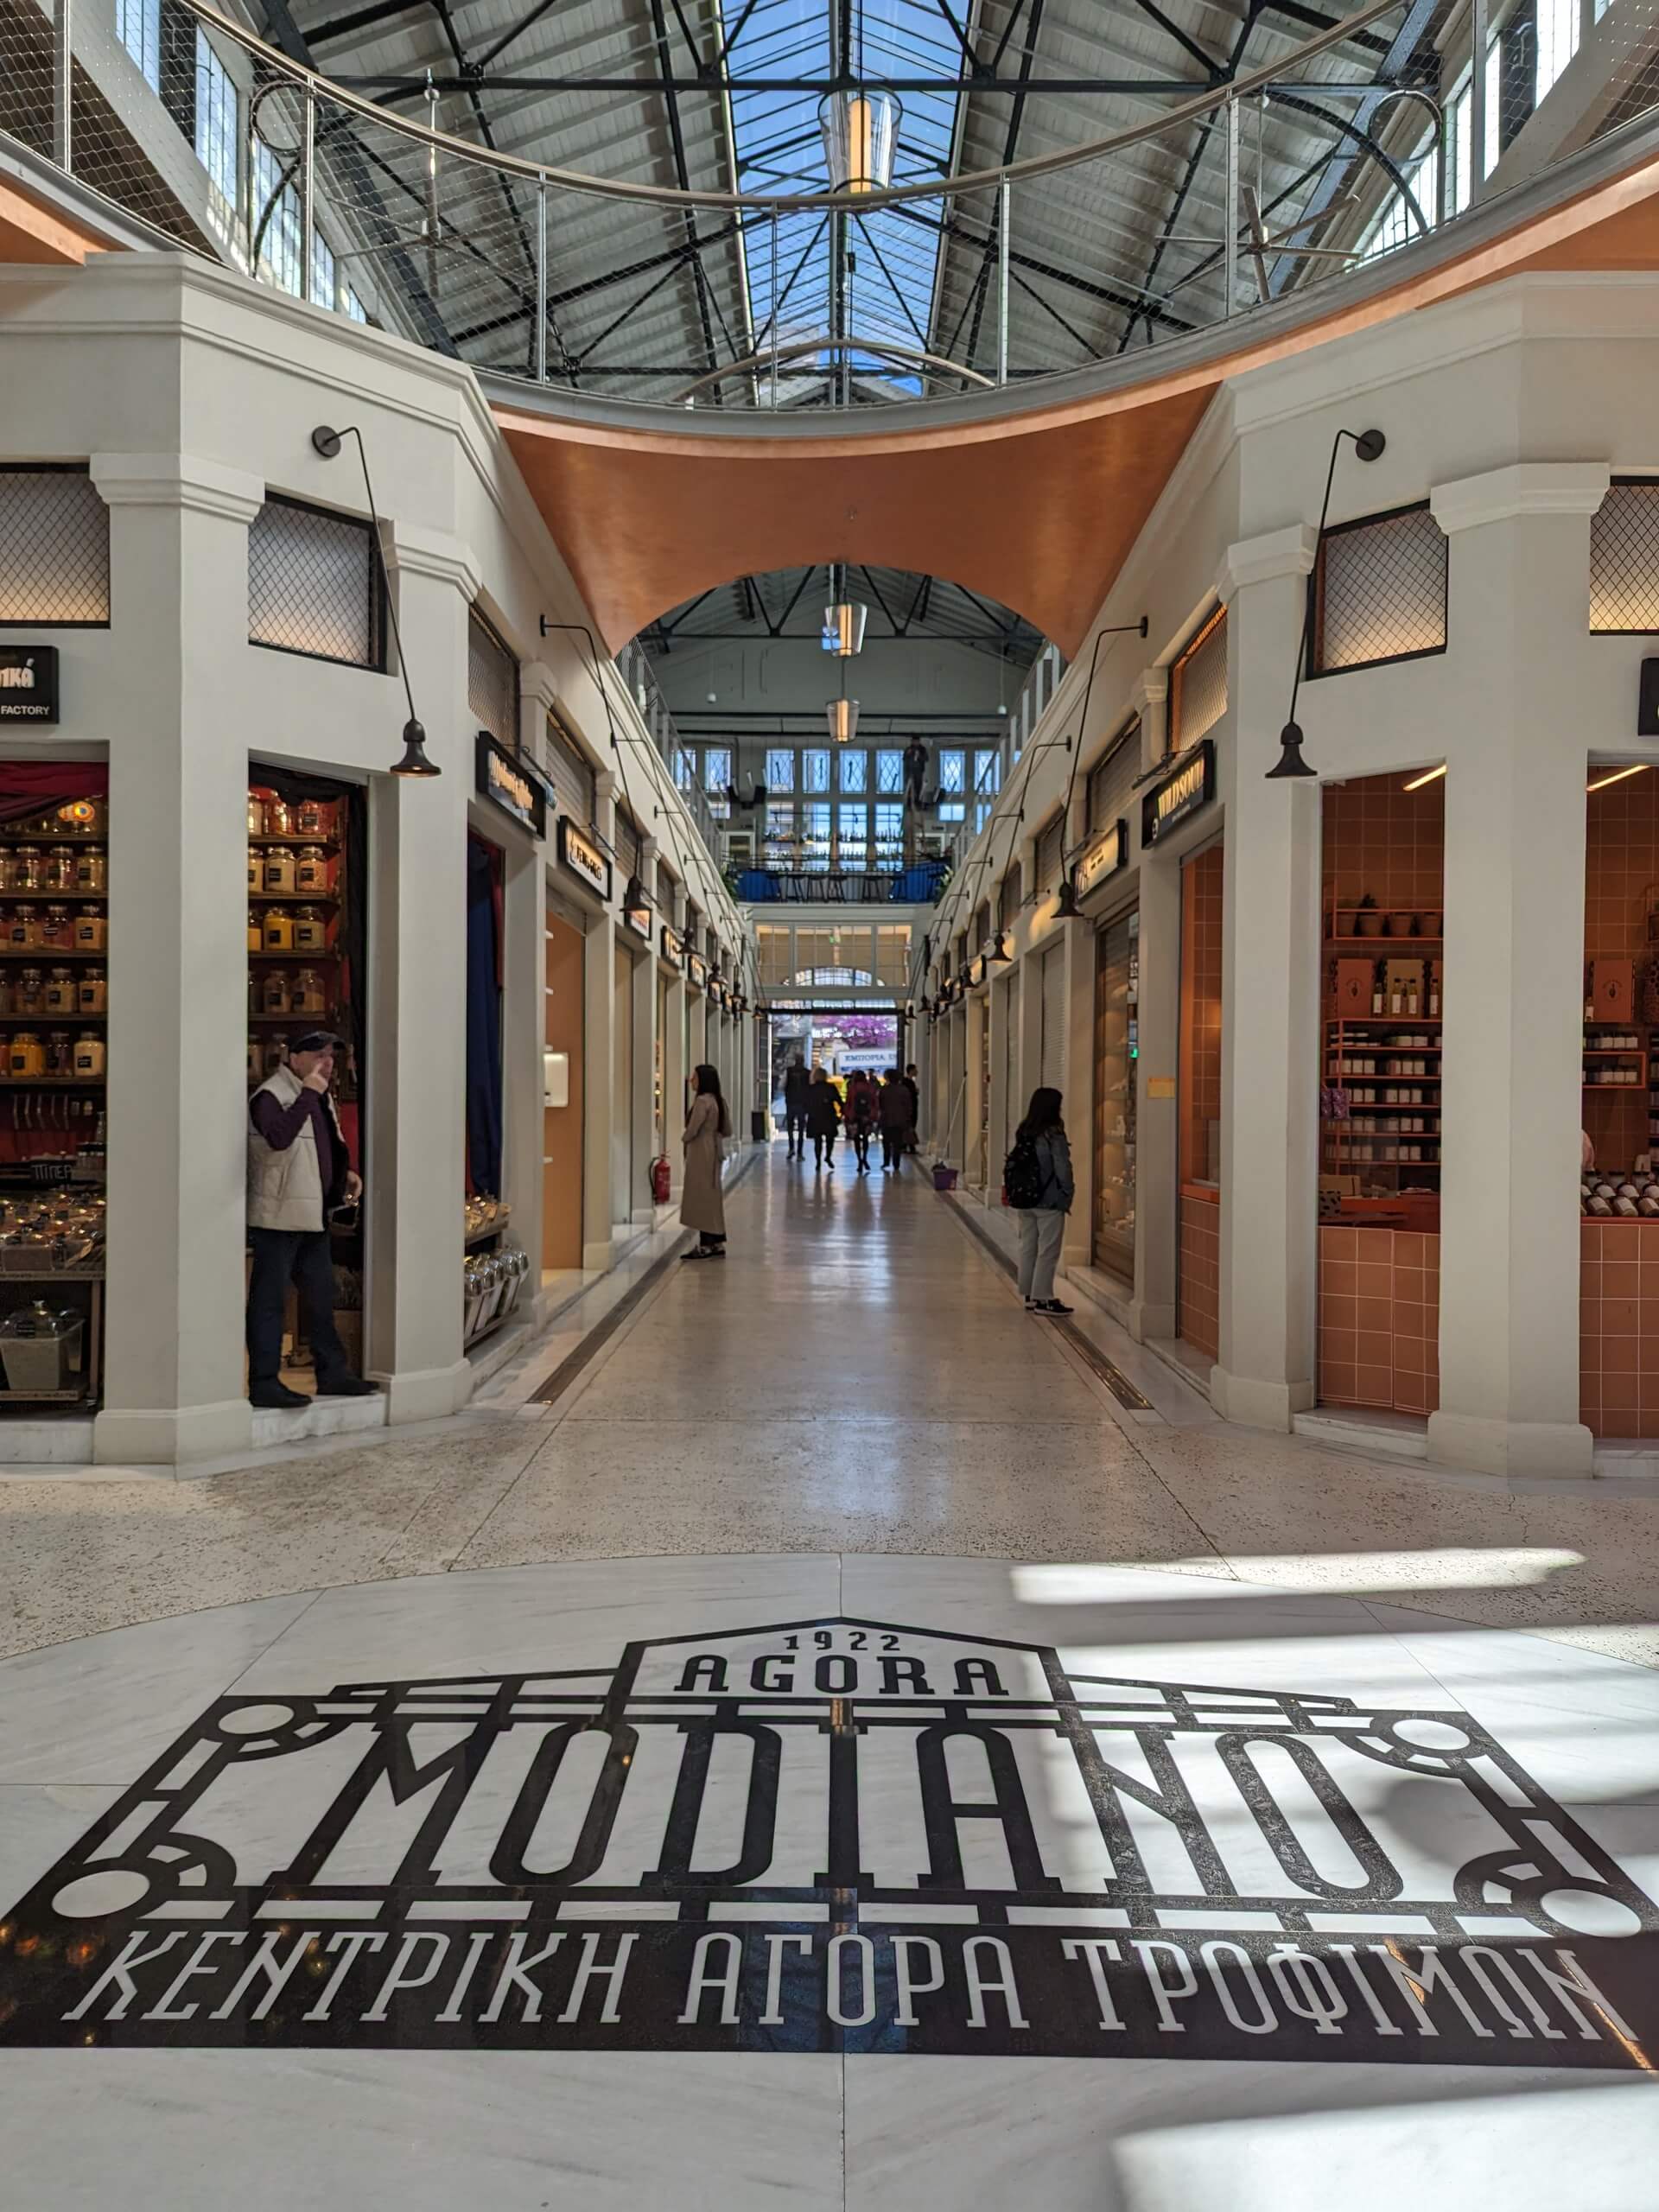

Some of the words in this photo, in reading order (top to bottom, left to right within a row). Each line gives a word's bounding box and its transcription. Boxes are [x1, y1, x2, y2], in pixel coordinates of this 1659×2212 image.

[1, 705, 49, 715] FACTORY
[785, 1630, 900, 1651] 1922
[673, 1655, 1009, 1696] AGORA
[263, 1721, 1404, 1901] MODIANO
[60, 1930, 640, 2024] ΚΕΝΤΡΙΚΗ
[677, 1931, 1030, 2031] ΑΓΟΡΑ
[1064, 1937, 1641, 2041] ΤΡΟΦΙΜΩΝ
